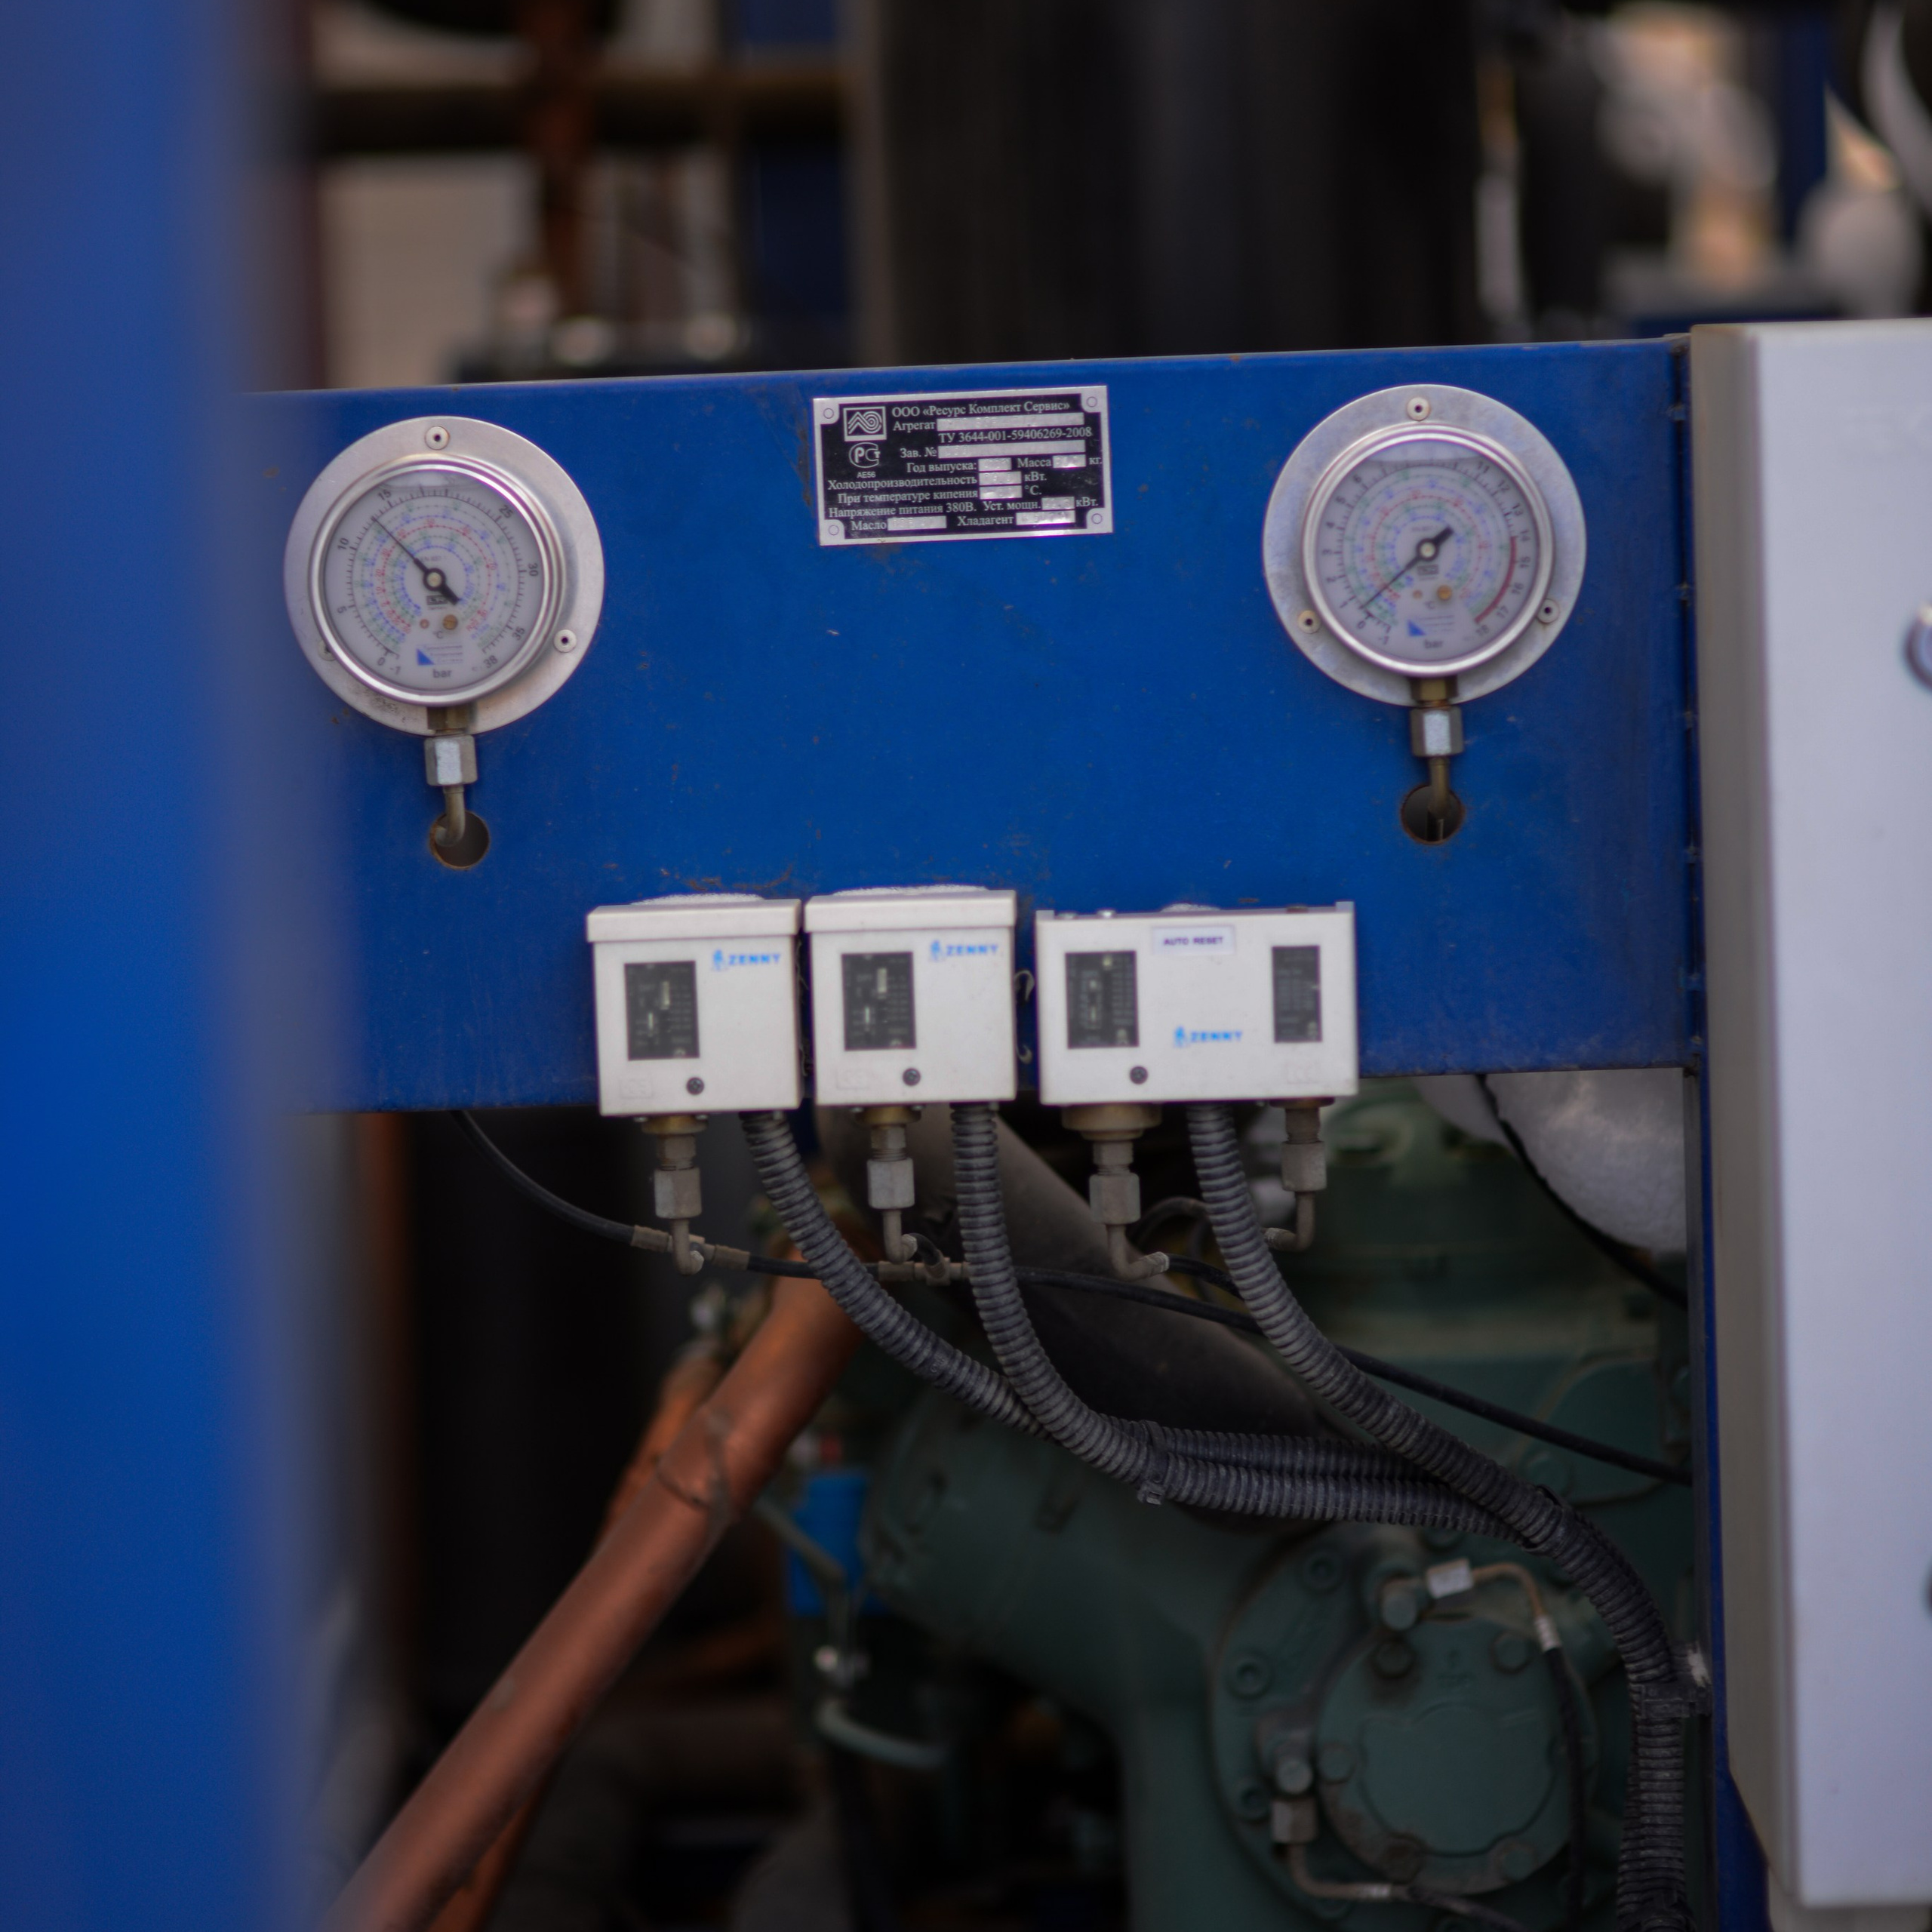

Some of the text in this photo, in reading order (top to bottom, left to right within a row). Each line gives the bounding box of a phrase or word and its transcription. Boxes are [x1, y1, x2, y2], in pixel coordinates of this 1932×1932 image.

[891, 401, 1070, 417] ООО «Ресурс Комплект Сервис»
[893, 421, 936, 432] Агрегат
[938, 432, 956, 443] ТУ
[900, 448, 921, 458] Зав.
[906, 463, 926, 473] Год
[928, 460, 977, 473] выпуска:
[1017, 457, 1052, 468] Масса
[1478, 461, 1490, 474] 11
[1024, 471, 1048, 481] кВт.
[828, 476, 978, 491] Холодопроизводительность
[377, 489, 392, 500] 15
[838, 493, 861, 506] При
[863, 491, 931, 503] температуре
[933, 491, 978, 500] кипения
[983, 500, 1004, 512] Уст.
[1007, 502, 1041, 511] мощн.
[1075, 497, 1099, 507] кВт.
[498, 504, 515, 518] 25
[828, 506, 897, 518] Напряжение
[899, 504, 943, 515] питания
[851, 520, 887, 531] Масло
[957, 515, 1014, 527] Хладагент
[337, 537, 349, 550] 10
[528, 562, 539, 577] 30
[1496, 605, 1509, 619] 17
[1357, 620, 1366, 629] 0
[512, 626, 525, 641] 35
[1424, 639, 1443, 649] bar
[377, 657, 386, 666] 0
[483, 655, 498, 669] 38
[432, 669, 452, 678] bar
[1163, 935, 1224, 946] AUTO RESET
[946, 943, 998, 957] ZENNY
[728, 953, 781, 966] ZENNY
[1190, 1030, 1243, 1043] ZENNY
